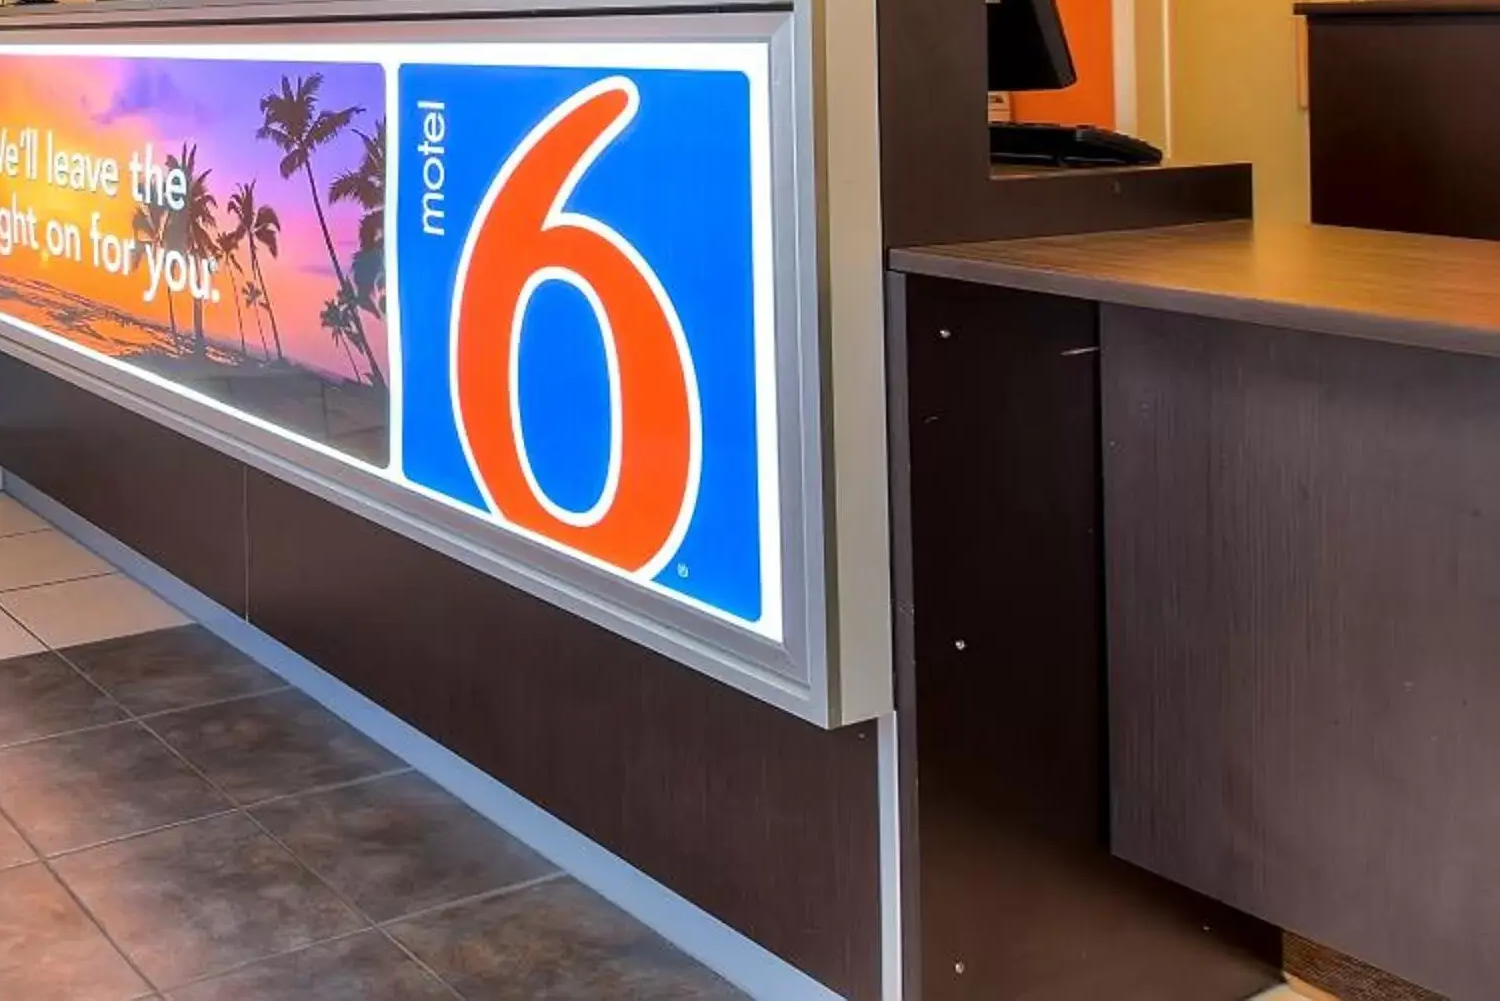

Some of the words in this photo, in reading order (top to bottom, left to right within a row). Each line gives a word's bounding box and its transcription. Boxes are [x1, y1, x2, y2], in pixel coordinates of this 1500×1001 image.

[46, 130, 120, 196] leave
[129, 142, 187, 210] the
[46, 218, 82, 263] on
[90, 211, 136, 276] for
[417, 100, 445, 236] motel
[449, 73, 703, 581] 6
